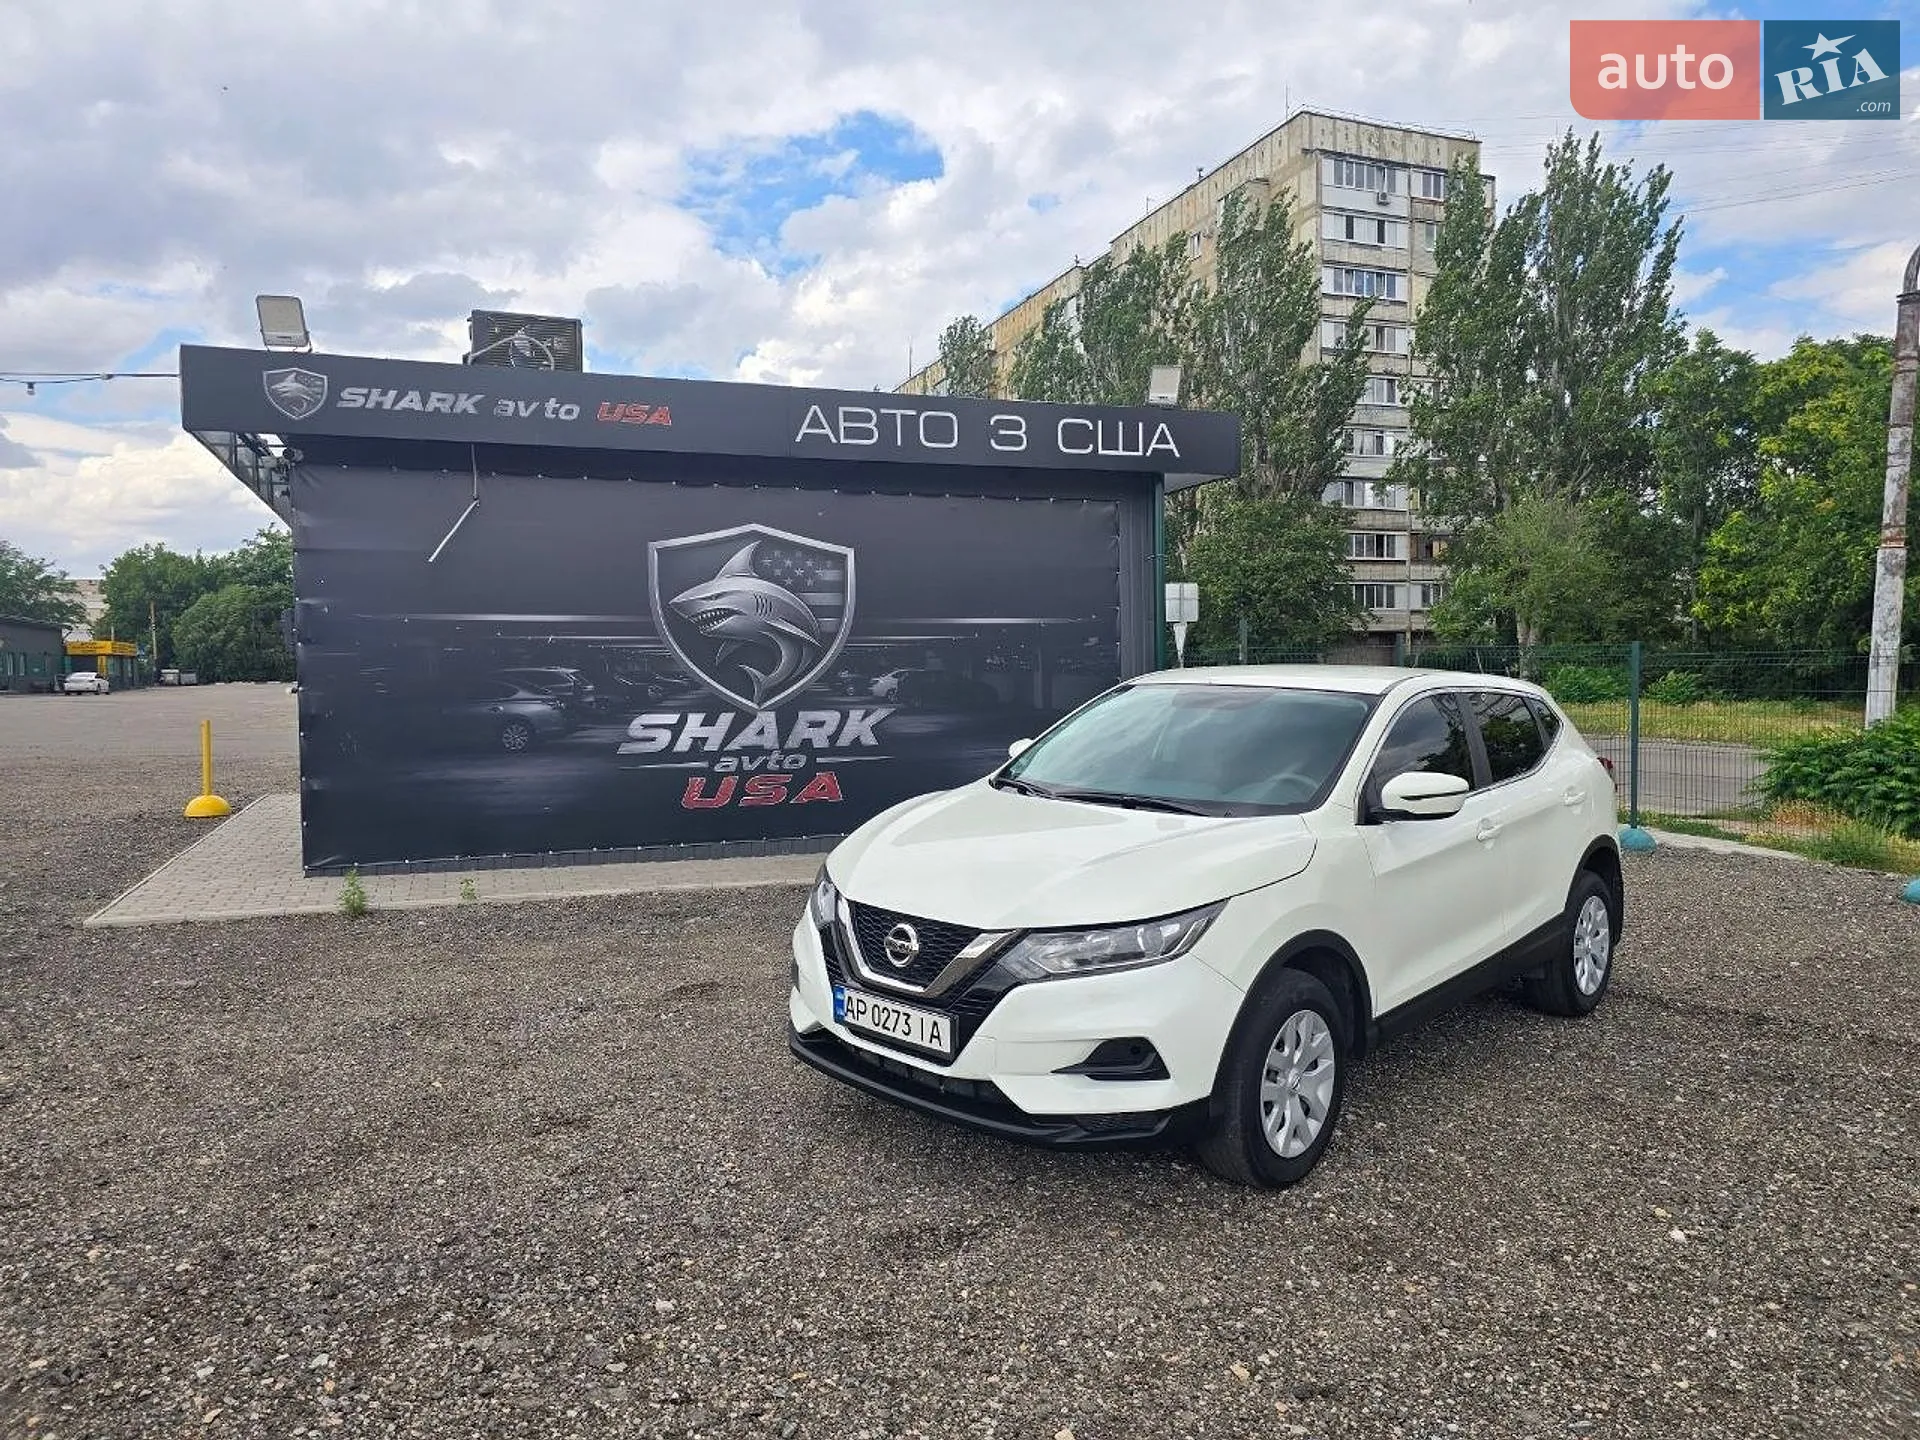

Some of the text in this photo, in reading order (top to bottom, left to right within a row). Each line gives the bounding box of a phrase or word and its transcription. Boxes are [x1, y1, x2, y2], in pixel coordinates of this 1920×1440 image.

[336, 387, 673, 426] SHARK avto USA
[795, 405, 1181, 458] АВТО З США
[616, 707, 897, 754] SHARK
[713, 749, 807, 773] avto
[680, 771, 843, 809] USA
[845, 995, 867, 1021] AP
[871, 1003, 912, 1036] 0273
